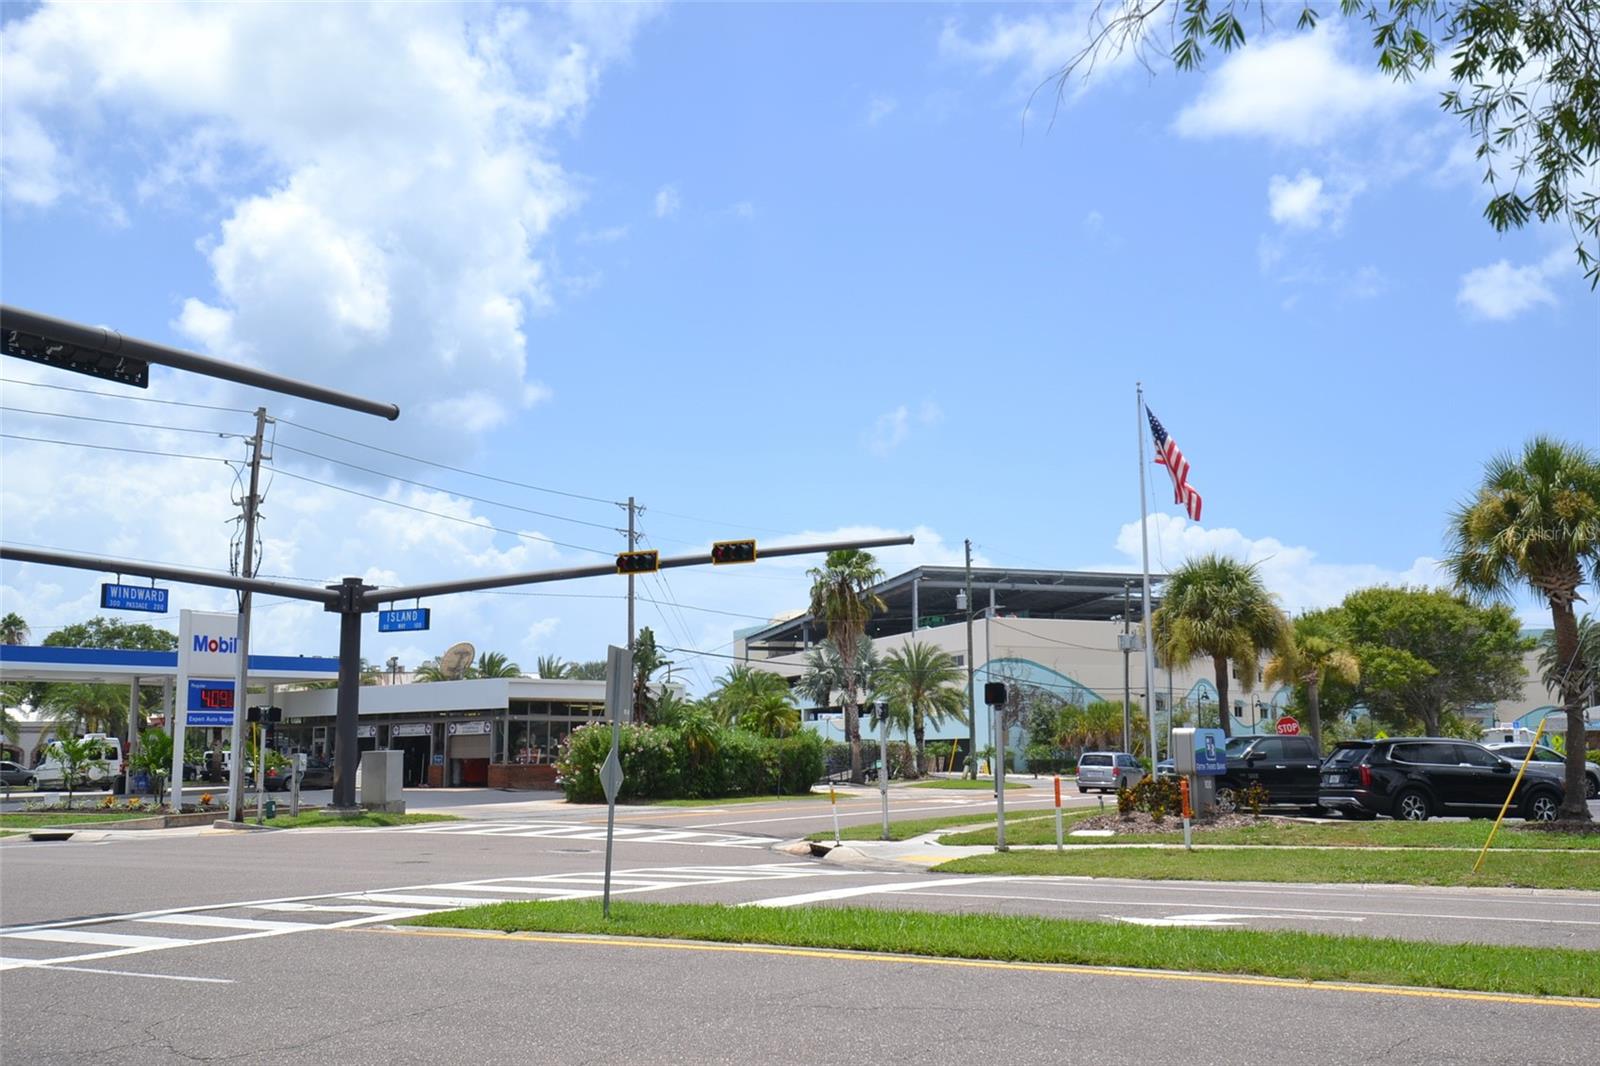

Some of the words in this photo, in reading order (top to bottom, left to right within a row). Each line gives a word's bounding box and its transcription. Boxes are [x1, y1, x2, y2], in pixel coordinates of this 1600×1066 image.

[110, 586, 165, 602] WINDWARD
[386, 611, 418, 622] ISLAND
[193, 634, 237, 653] Mobil
[1278, 723, 1298, 734] STOP
